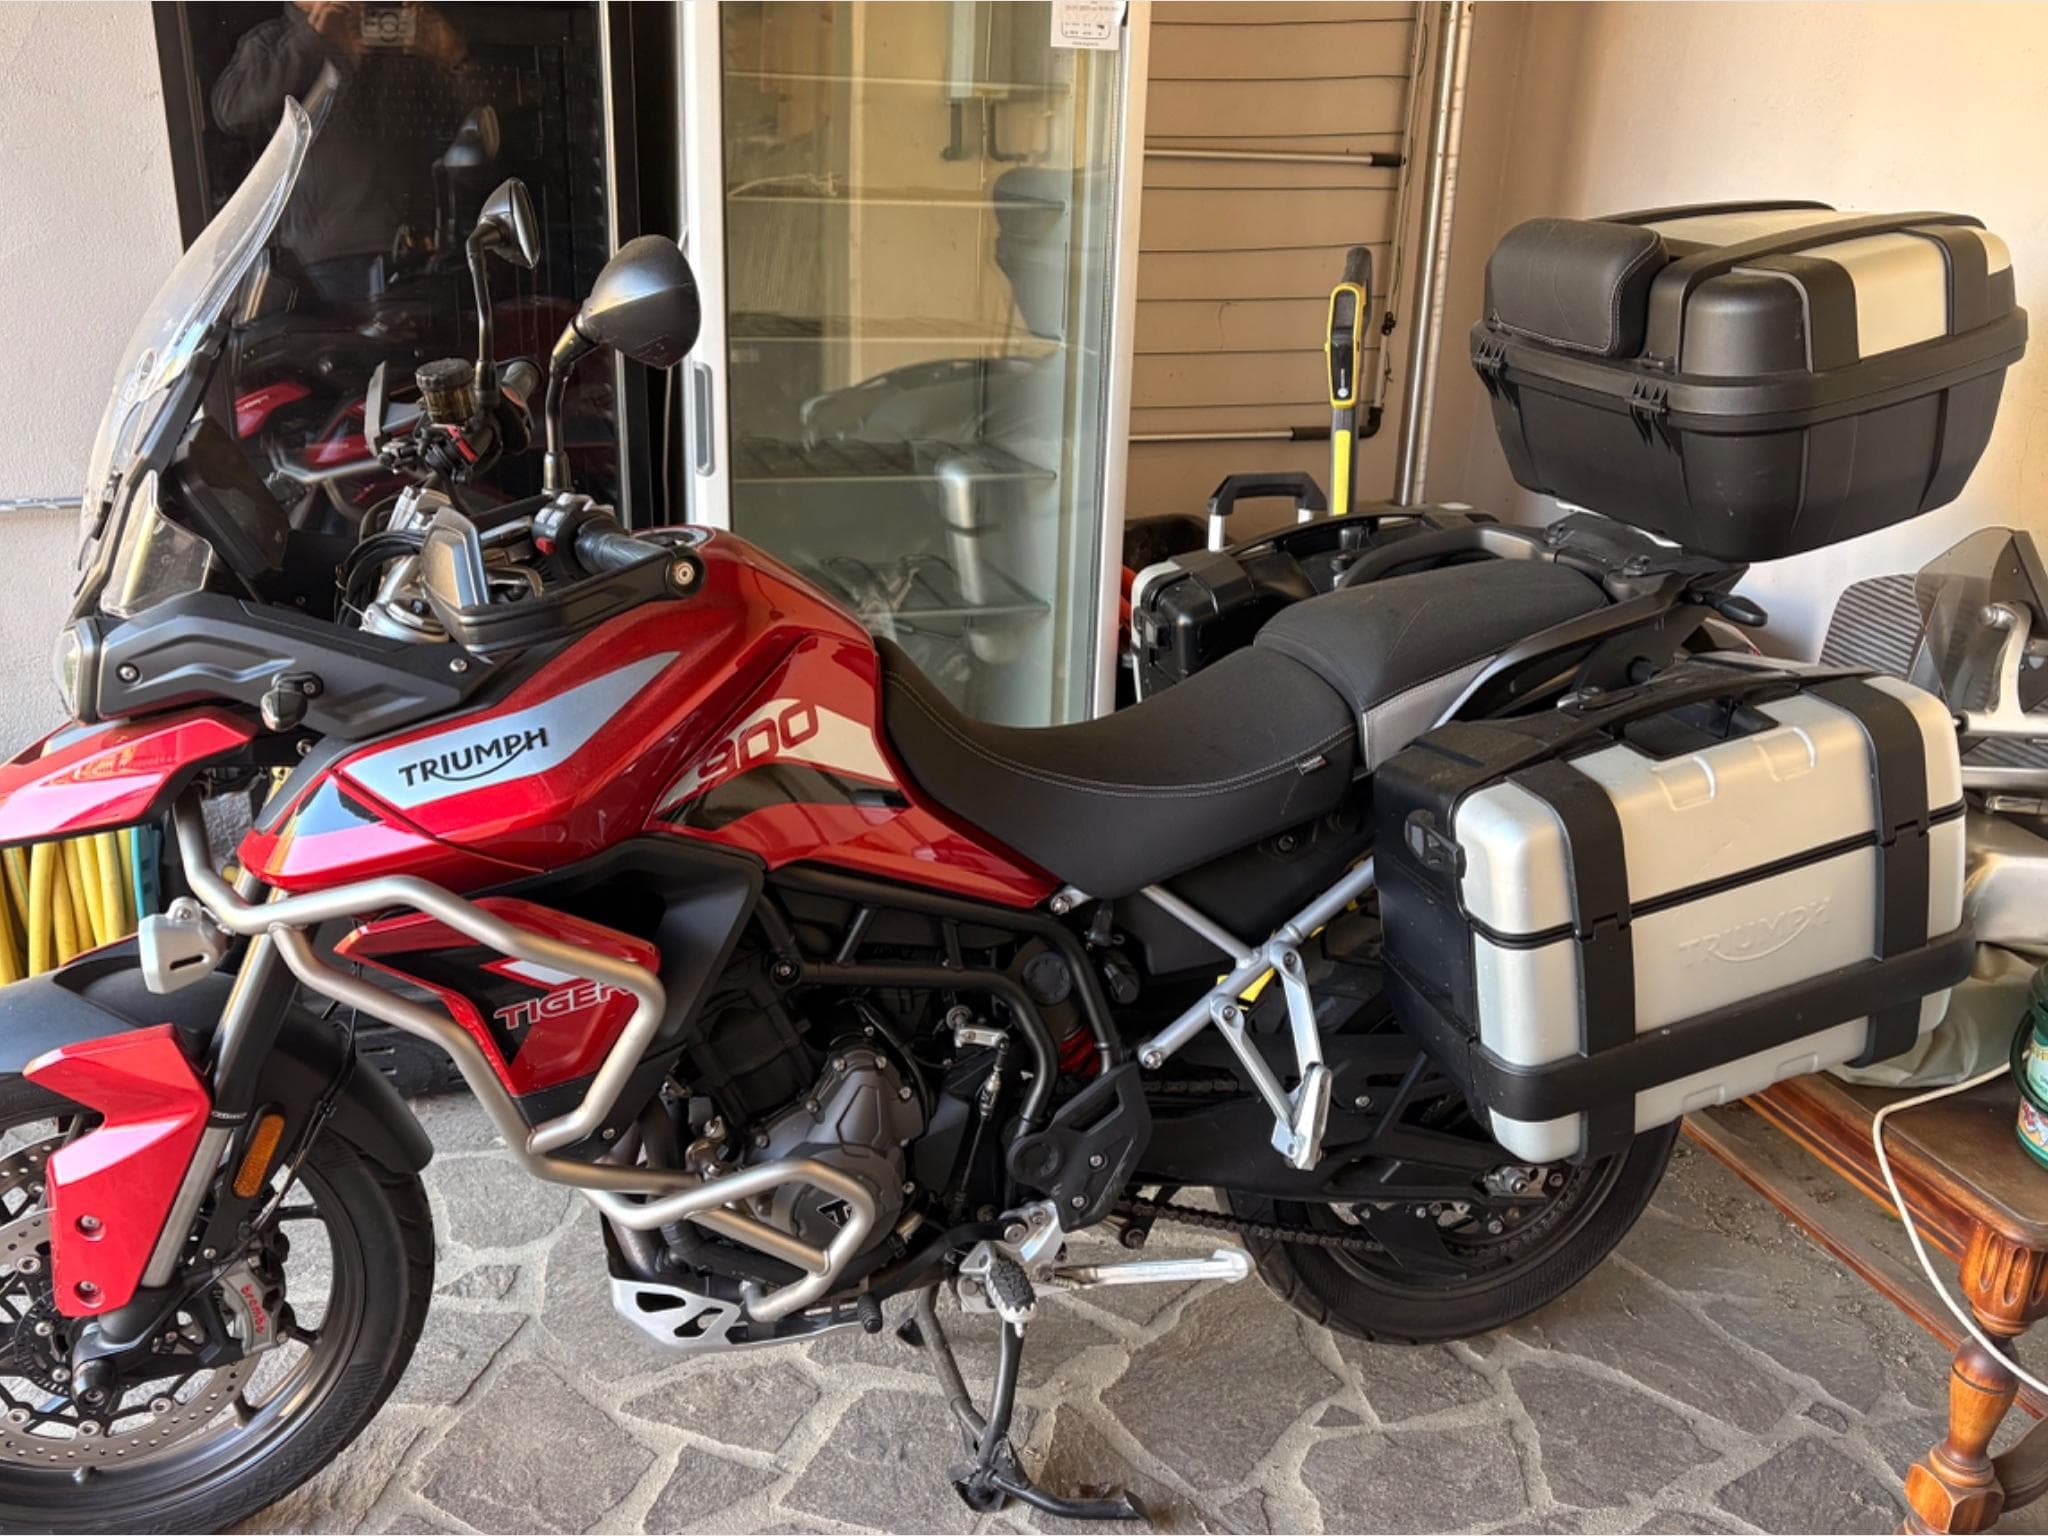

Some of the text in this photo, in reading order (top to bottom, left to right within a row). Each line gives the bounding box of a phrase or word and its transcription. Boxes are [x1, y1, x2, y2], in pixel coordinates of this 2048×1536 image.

[398, 727, 549, 787] TRIUMPH
[697, 701, 819, 790] 900
[1678, 897, 1832, 969] TRIUMPH
[241, 1282, 267, 1336] brembo
